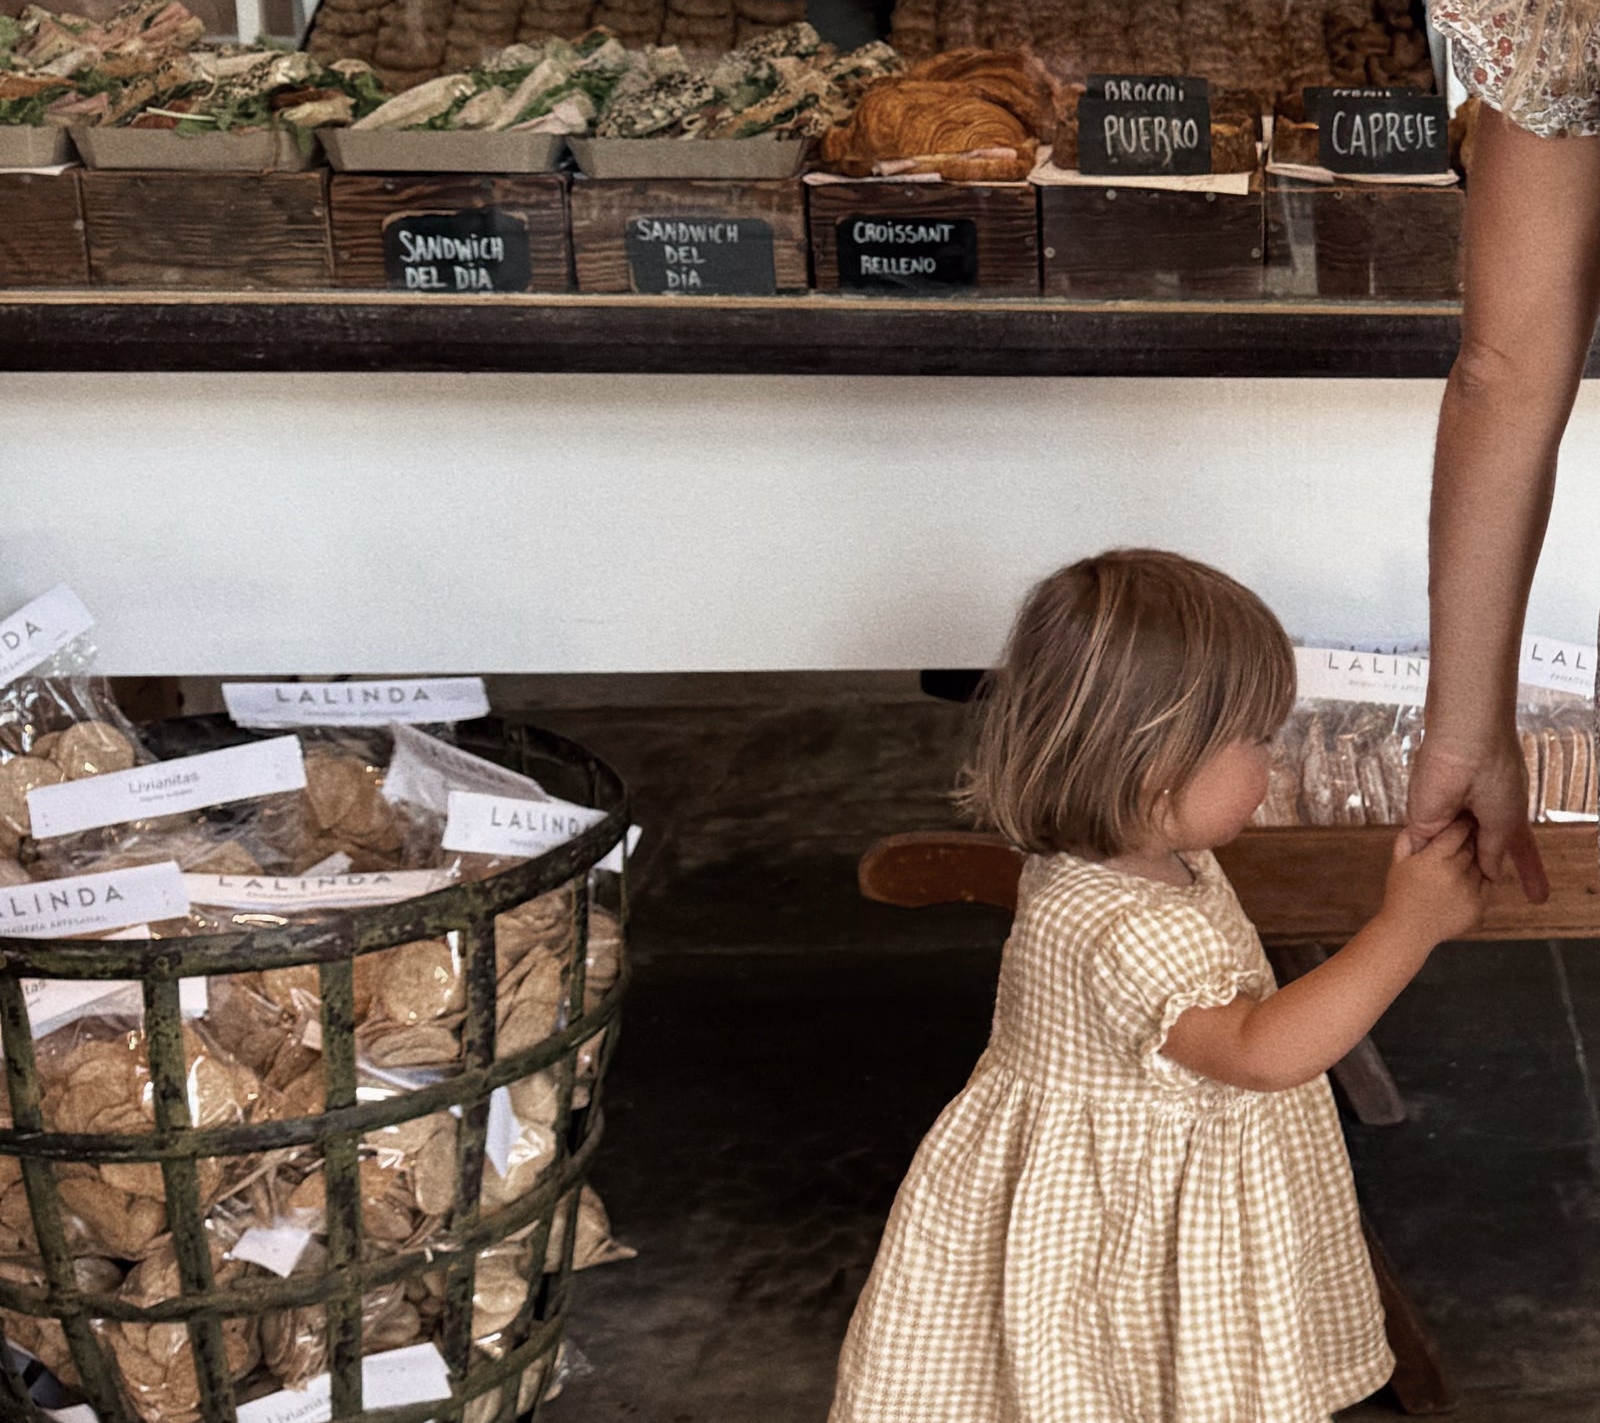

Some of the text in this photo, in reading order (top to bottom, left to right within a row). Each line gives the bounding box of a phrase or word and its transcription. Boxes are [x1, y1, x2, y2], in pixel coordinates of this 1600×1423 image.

[1104, 115, 1198, 166] PUERRO
[1332, 111, 1437, 158] CAPRESE
[664, 245, 705, 264] DEL
[860, 255, 936, 275] RELLENO
[405, 266, 448, 289] DEL
[1329, 652, 1421, 676] LALIN
[275, 687, 430, 705] LALINDA
